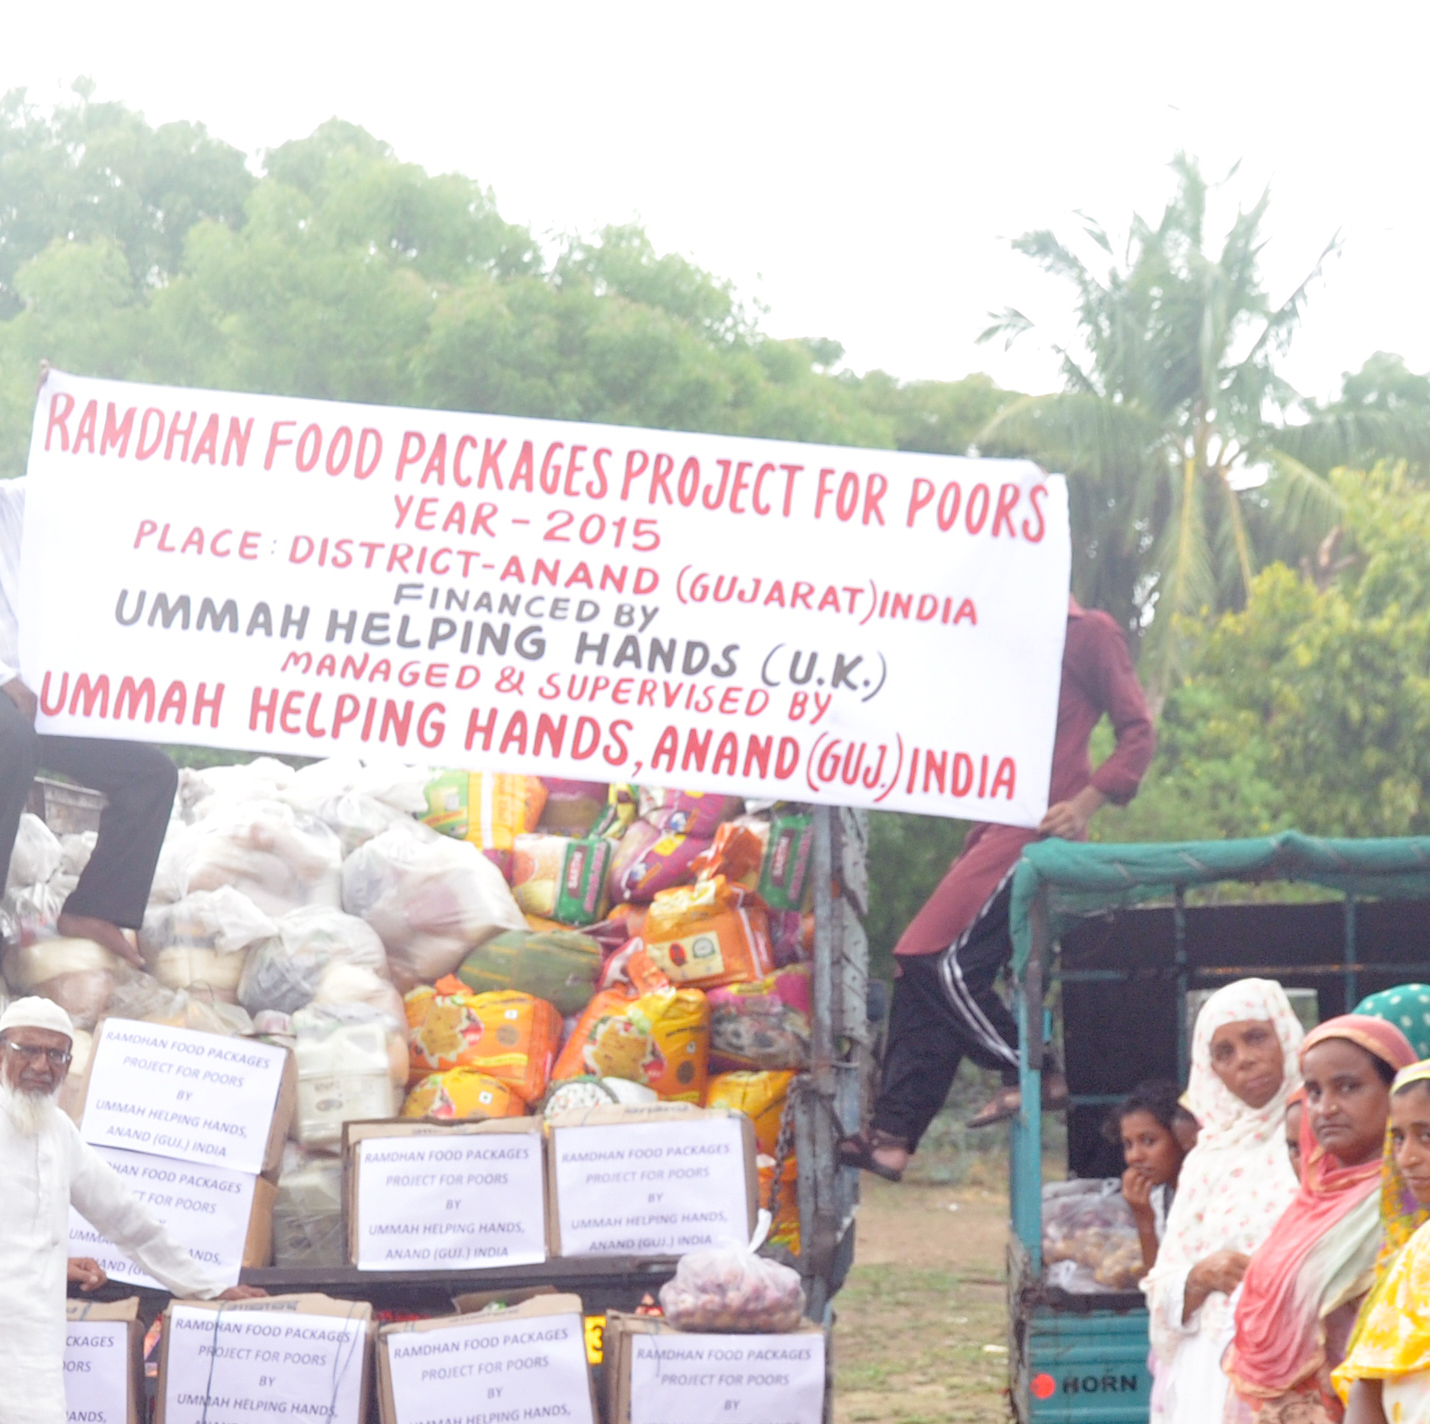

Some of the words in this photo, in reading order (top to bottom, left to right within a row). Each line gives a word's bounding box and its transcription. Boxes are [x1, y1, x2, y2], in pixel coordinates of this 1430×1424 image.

[44, 392, 255, 466] RAMDHAN
[264, 421, 383, 480] FOOD
[395, 431, 612, 500] PACKAGES
[621, 449, 805, 518] PROJECT
[814, 468, 888, 526] FOR
[906, 478, 1048, 543] POORS
[393, 582, 600, 622] FINANCED
[614, 603, 659, 633] BY
[115, 588, 310, 640] UMMAH
[325, 609, 546, 661] HELPING
[575, 631, 740, 677] HANDS
[761, 643, 887, 702] (U.K.)
[281, 651, 480, 689] MANAGED
[494, 666, 524, 696] &
[538, 672, 769, 716] SUPERVISED
[788, 690, 832, 725] BY
[39, 671, 225, 728] UMMAH
[248, 686, 446, 748] HELPING
[650, 725, 800, 780] ANAND
[106, 1032, 168, 1049] RAMDHAN
[170, 1041, 205, 1056] FOOD
[207, 1048, 270, 1069] PACKAGES
[123, 1056, 174, 1073] PROJECT
[175, 1065, 200, 1079] FOR
[202, 1070, 244, 1088] POORS
[176, 1090, 193, 1101] BY
[96, 1100, 146, 1116] UMMAH
[148, 1109, 200, 1127] HELPING
[107, 1125, 151, 1142] ANAND
[192, 1142, 226, 1157] INDIA
[364, 1151, 425, 1163] RAMDHAN
[428, 1150, 463, 1161] FOOD
[466, 1148, 529, 1160] PACKAGES
[386, 1174, 436, 1186] PROJECT
[439, 1174, 464, 1186] FOR
[467, 1173, 508, 1185] POORS
[446, 1199, 461, 1210] BY
[369, 1224, 419, 1235] UMMAH
[423, 1223, 475, 1234] HELPING
[385, 1248, 431, 1259] ANAND
[474, 1247, 508, 1257] INDIA
[175, 1319, 243, 1337] RAMDHAN
[245, 1324, 282, 1337] FOOD
[285, 1327, 350, 1343] PACKAGES
[394, 1342, 460, 1359] RAMDHAN
[464, 1337, 500, 1350] FOOD
[503, 1328, 568, 1345] PACKAGES
[198, 1345, 252, 1360] PROJECT
[254, 1349, 280, 1362] FOR
[283, 1352, 327, 1366] POORS
[421, 1364, 474, 1381] PROJECT
[478, 1361, 503, 1374] FOR
[506, 1356, 549, 1371] POORS
[259, 1375, 275, 1387] BY
[1062, 1375, 1138, 1394] HORN
[177, 1394, 230, 1408] UMMAH
[233, 1399, 287, 1413] HELPING
[487, 1387, 502, 1399] BY
[523, 1404, 571, 1419] HANDS,
